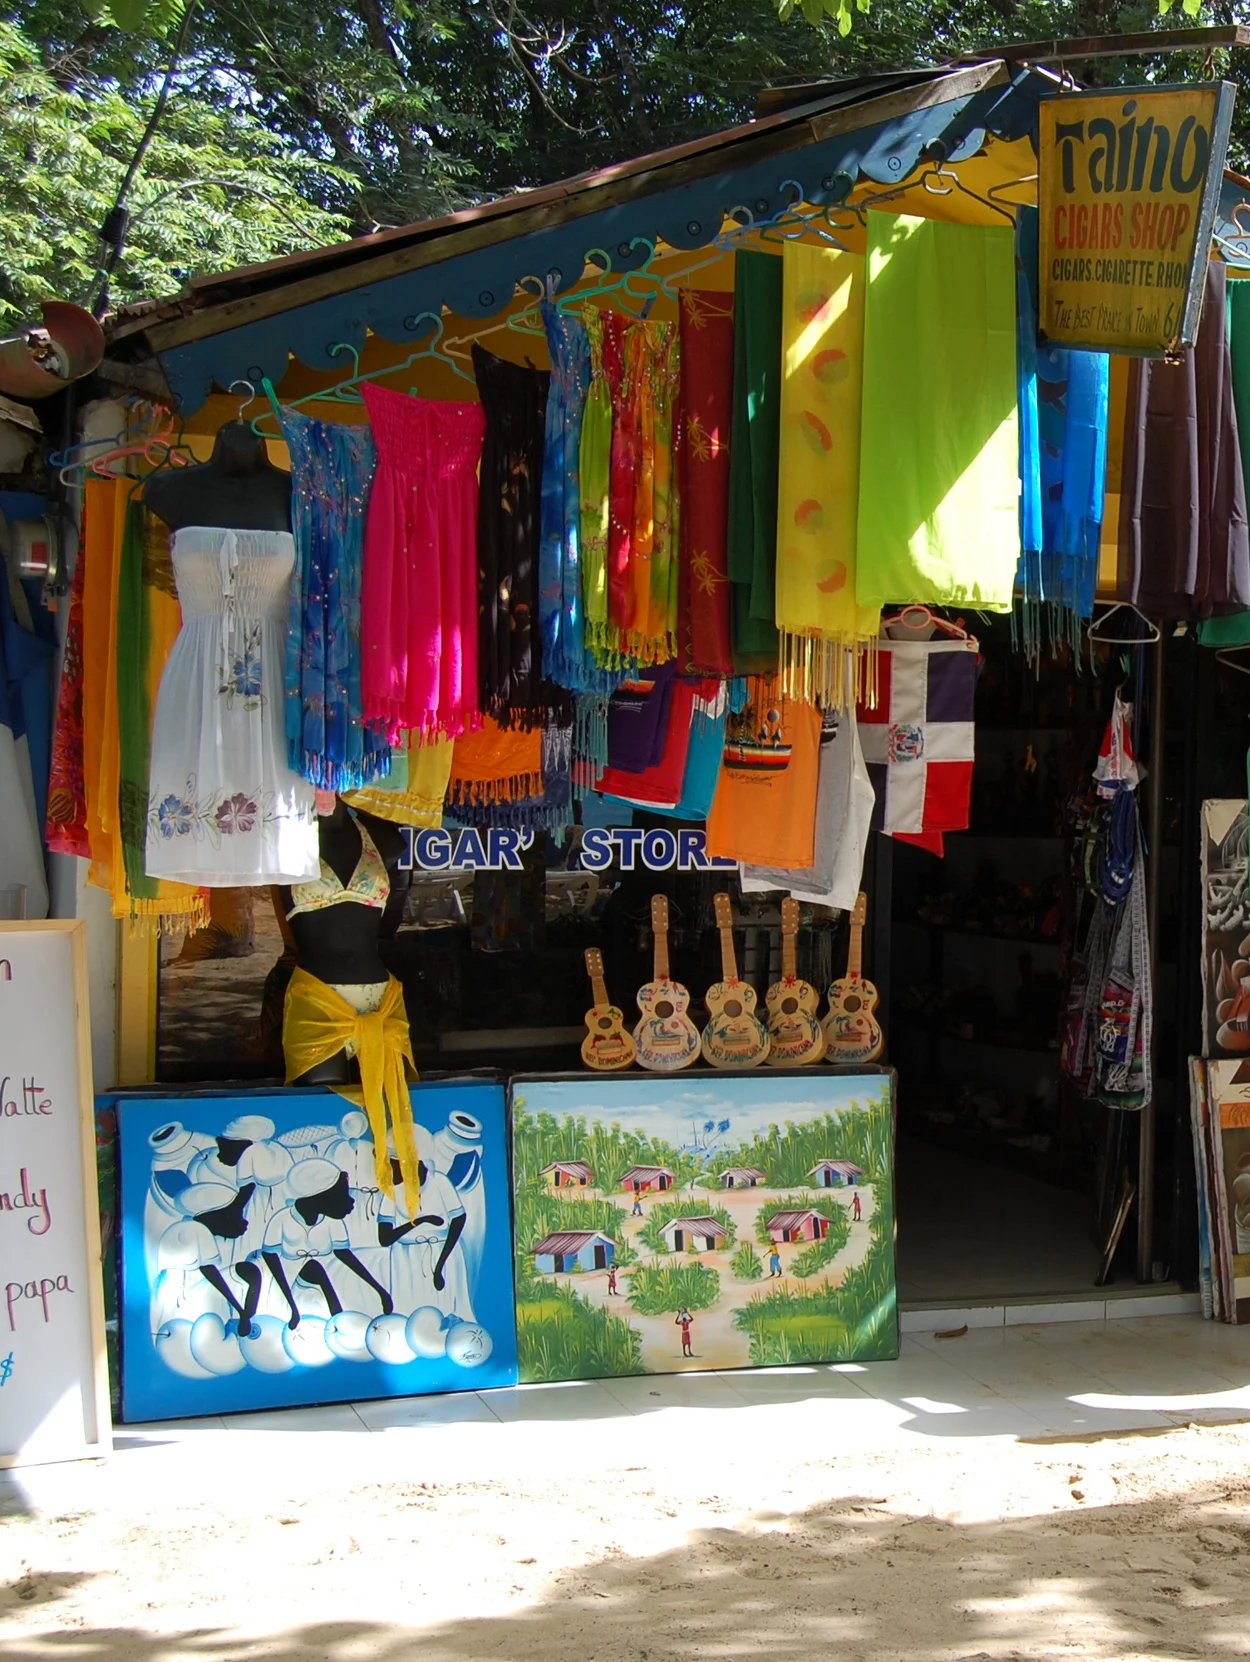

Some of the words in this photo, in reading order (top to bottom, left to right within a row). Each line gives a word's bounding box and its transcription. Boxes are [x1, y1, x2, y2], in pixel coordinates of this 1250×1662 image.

[1053, 202, 1124, 251] CIGARS
[1129, 201, 1191, 252] SHOP
[5, 1275, 75, 1331] papa
